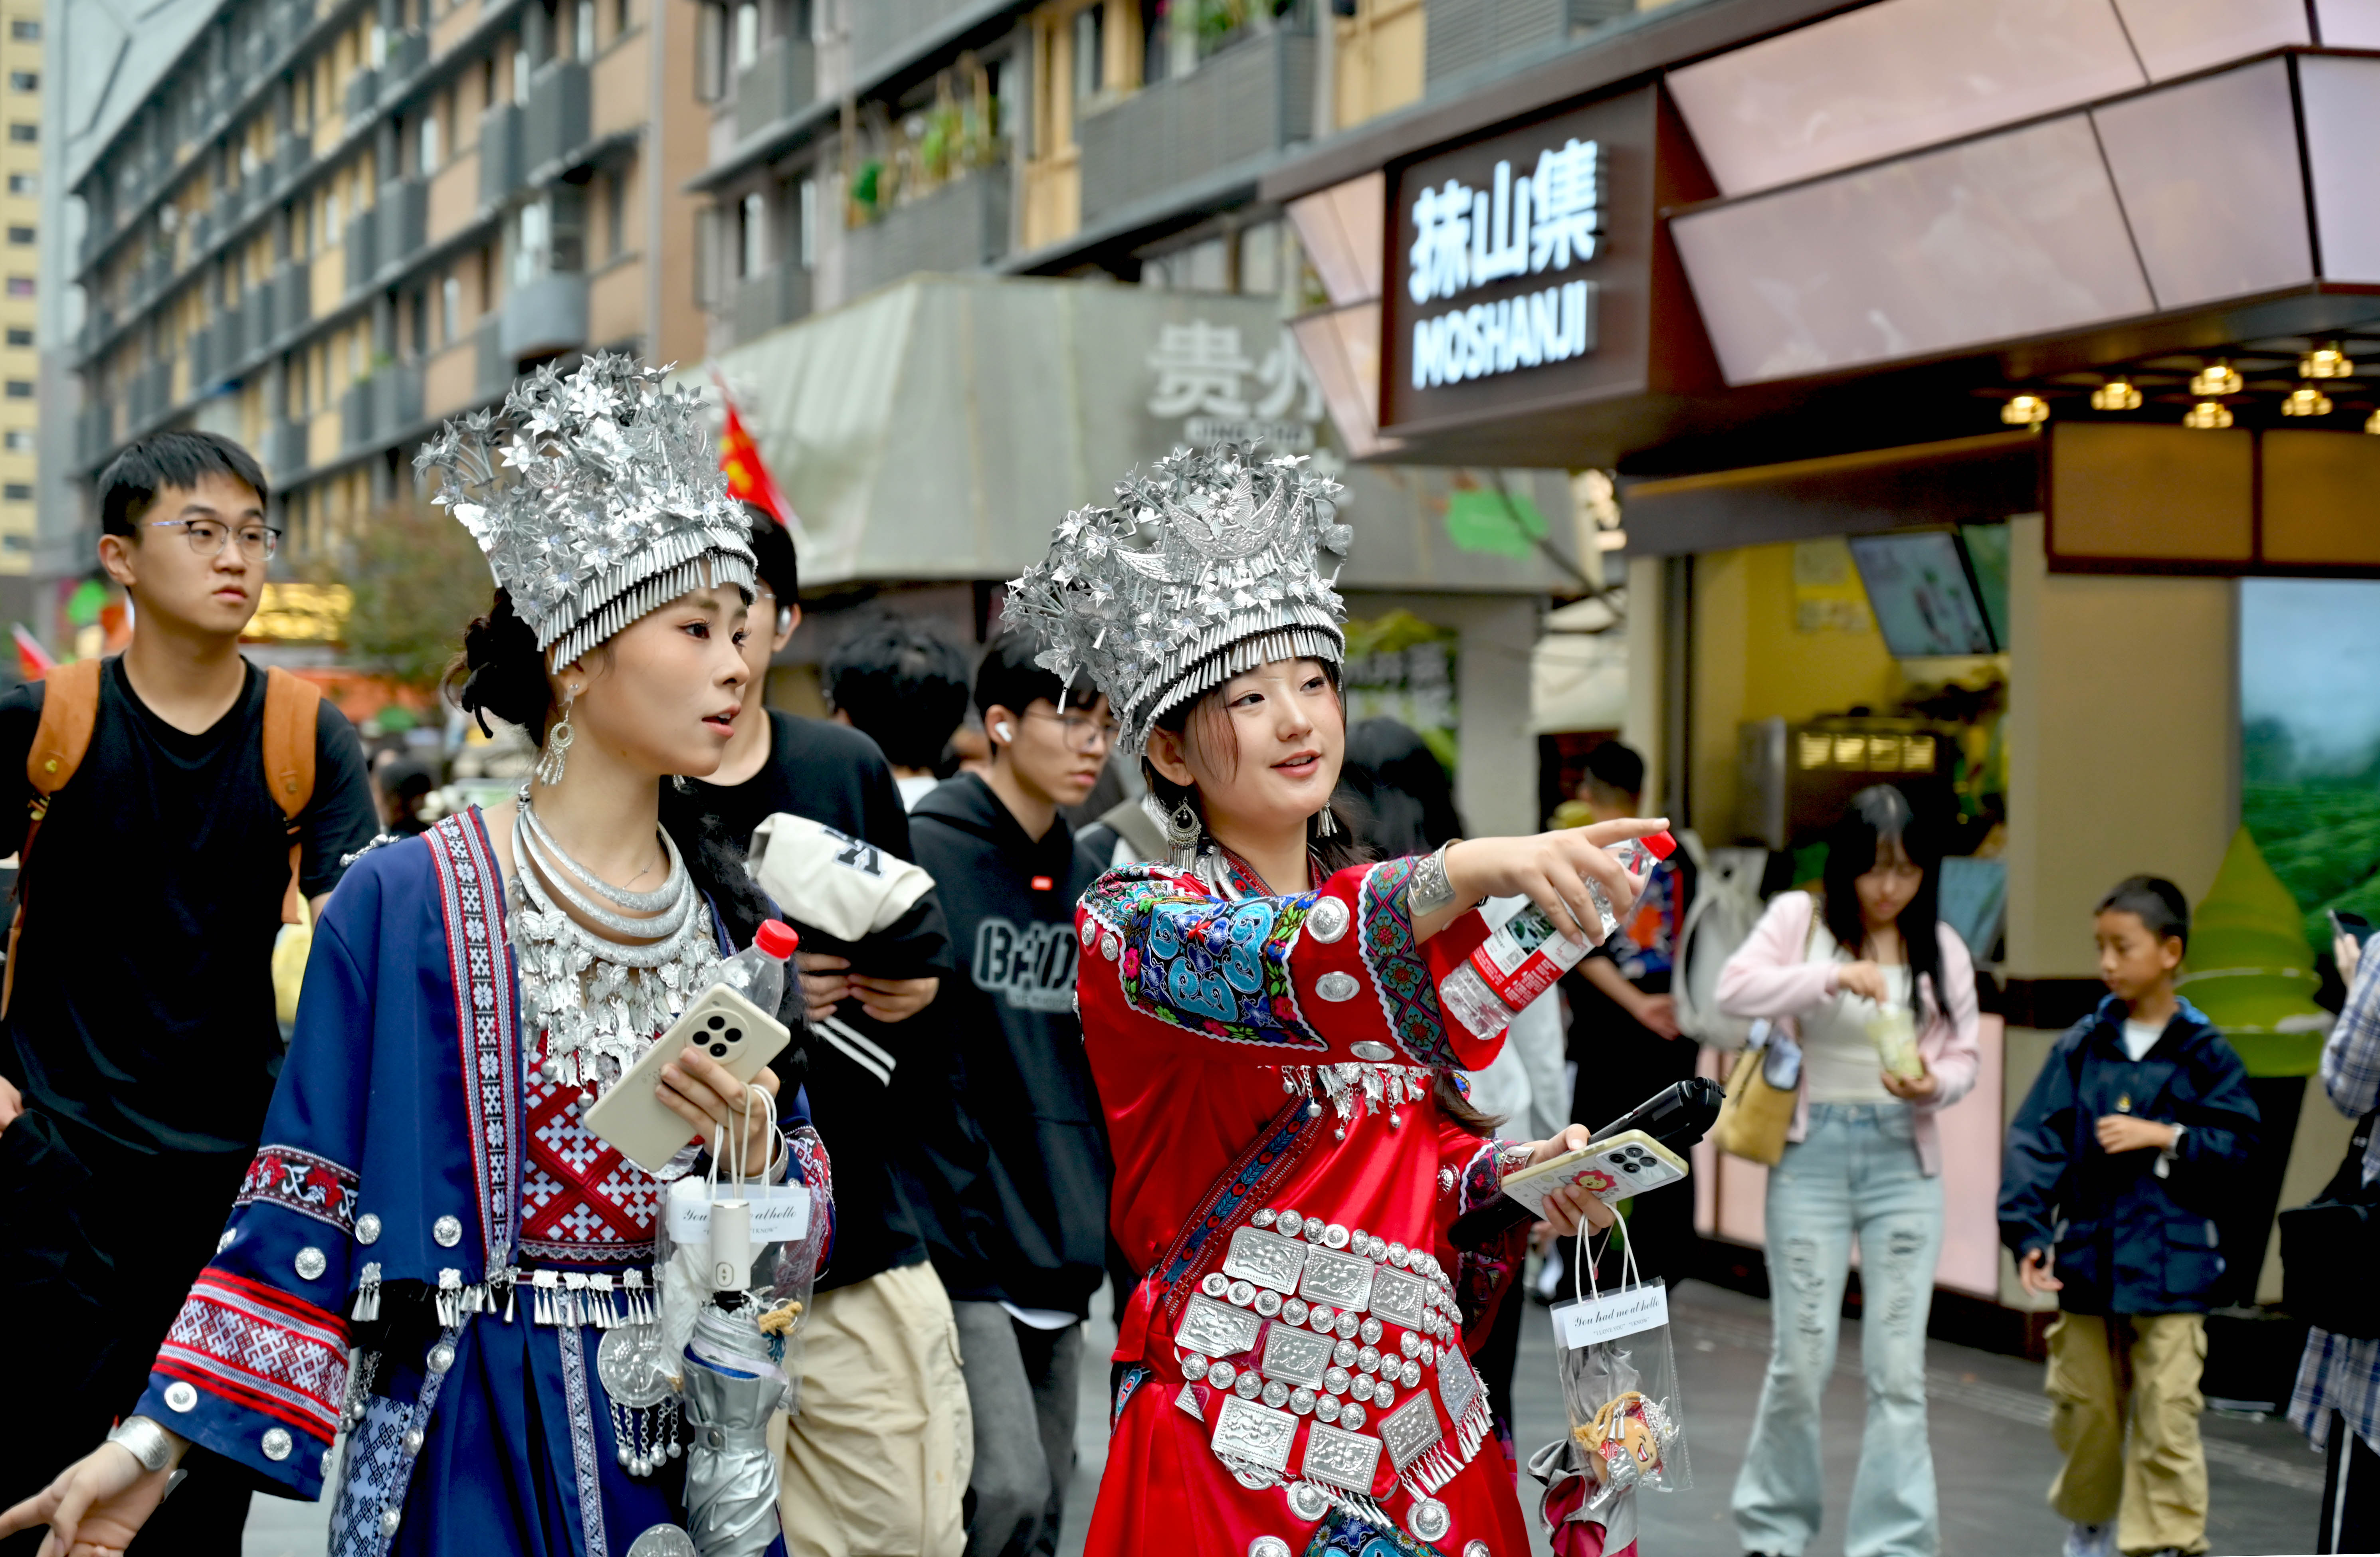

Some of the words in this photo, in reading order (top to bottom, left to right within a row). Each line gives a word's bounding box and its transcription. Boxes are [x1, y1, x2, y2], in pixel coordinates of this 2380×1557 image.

[1412, 280, 1588, 390] MOSHANJI
[683, 1209, 708, 1221] You
[770, 1206, 796, 1219] hello
[1573, 1316, 1593, 1328] You
[1595, 1309, 1614, 1323] had
[1616, 1309, 1629, 1318] me
[1641, 1296, 1659, 1311] hello
